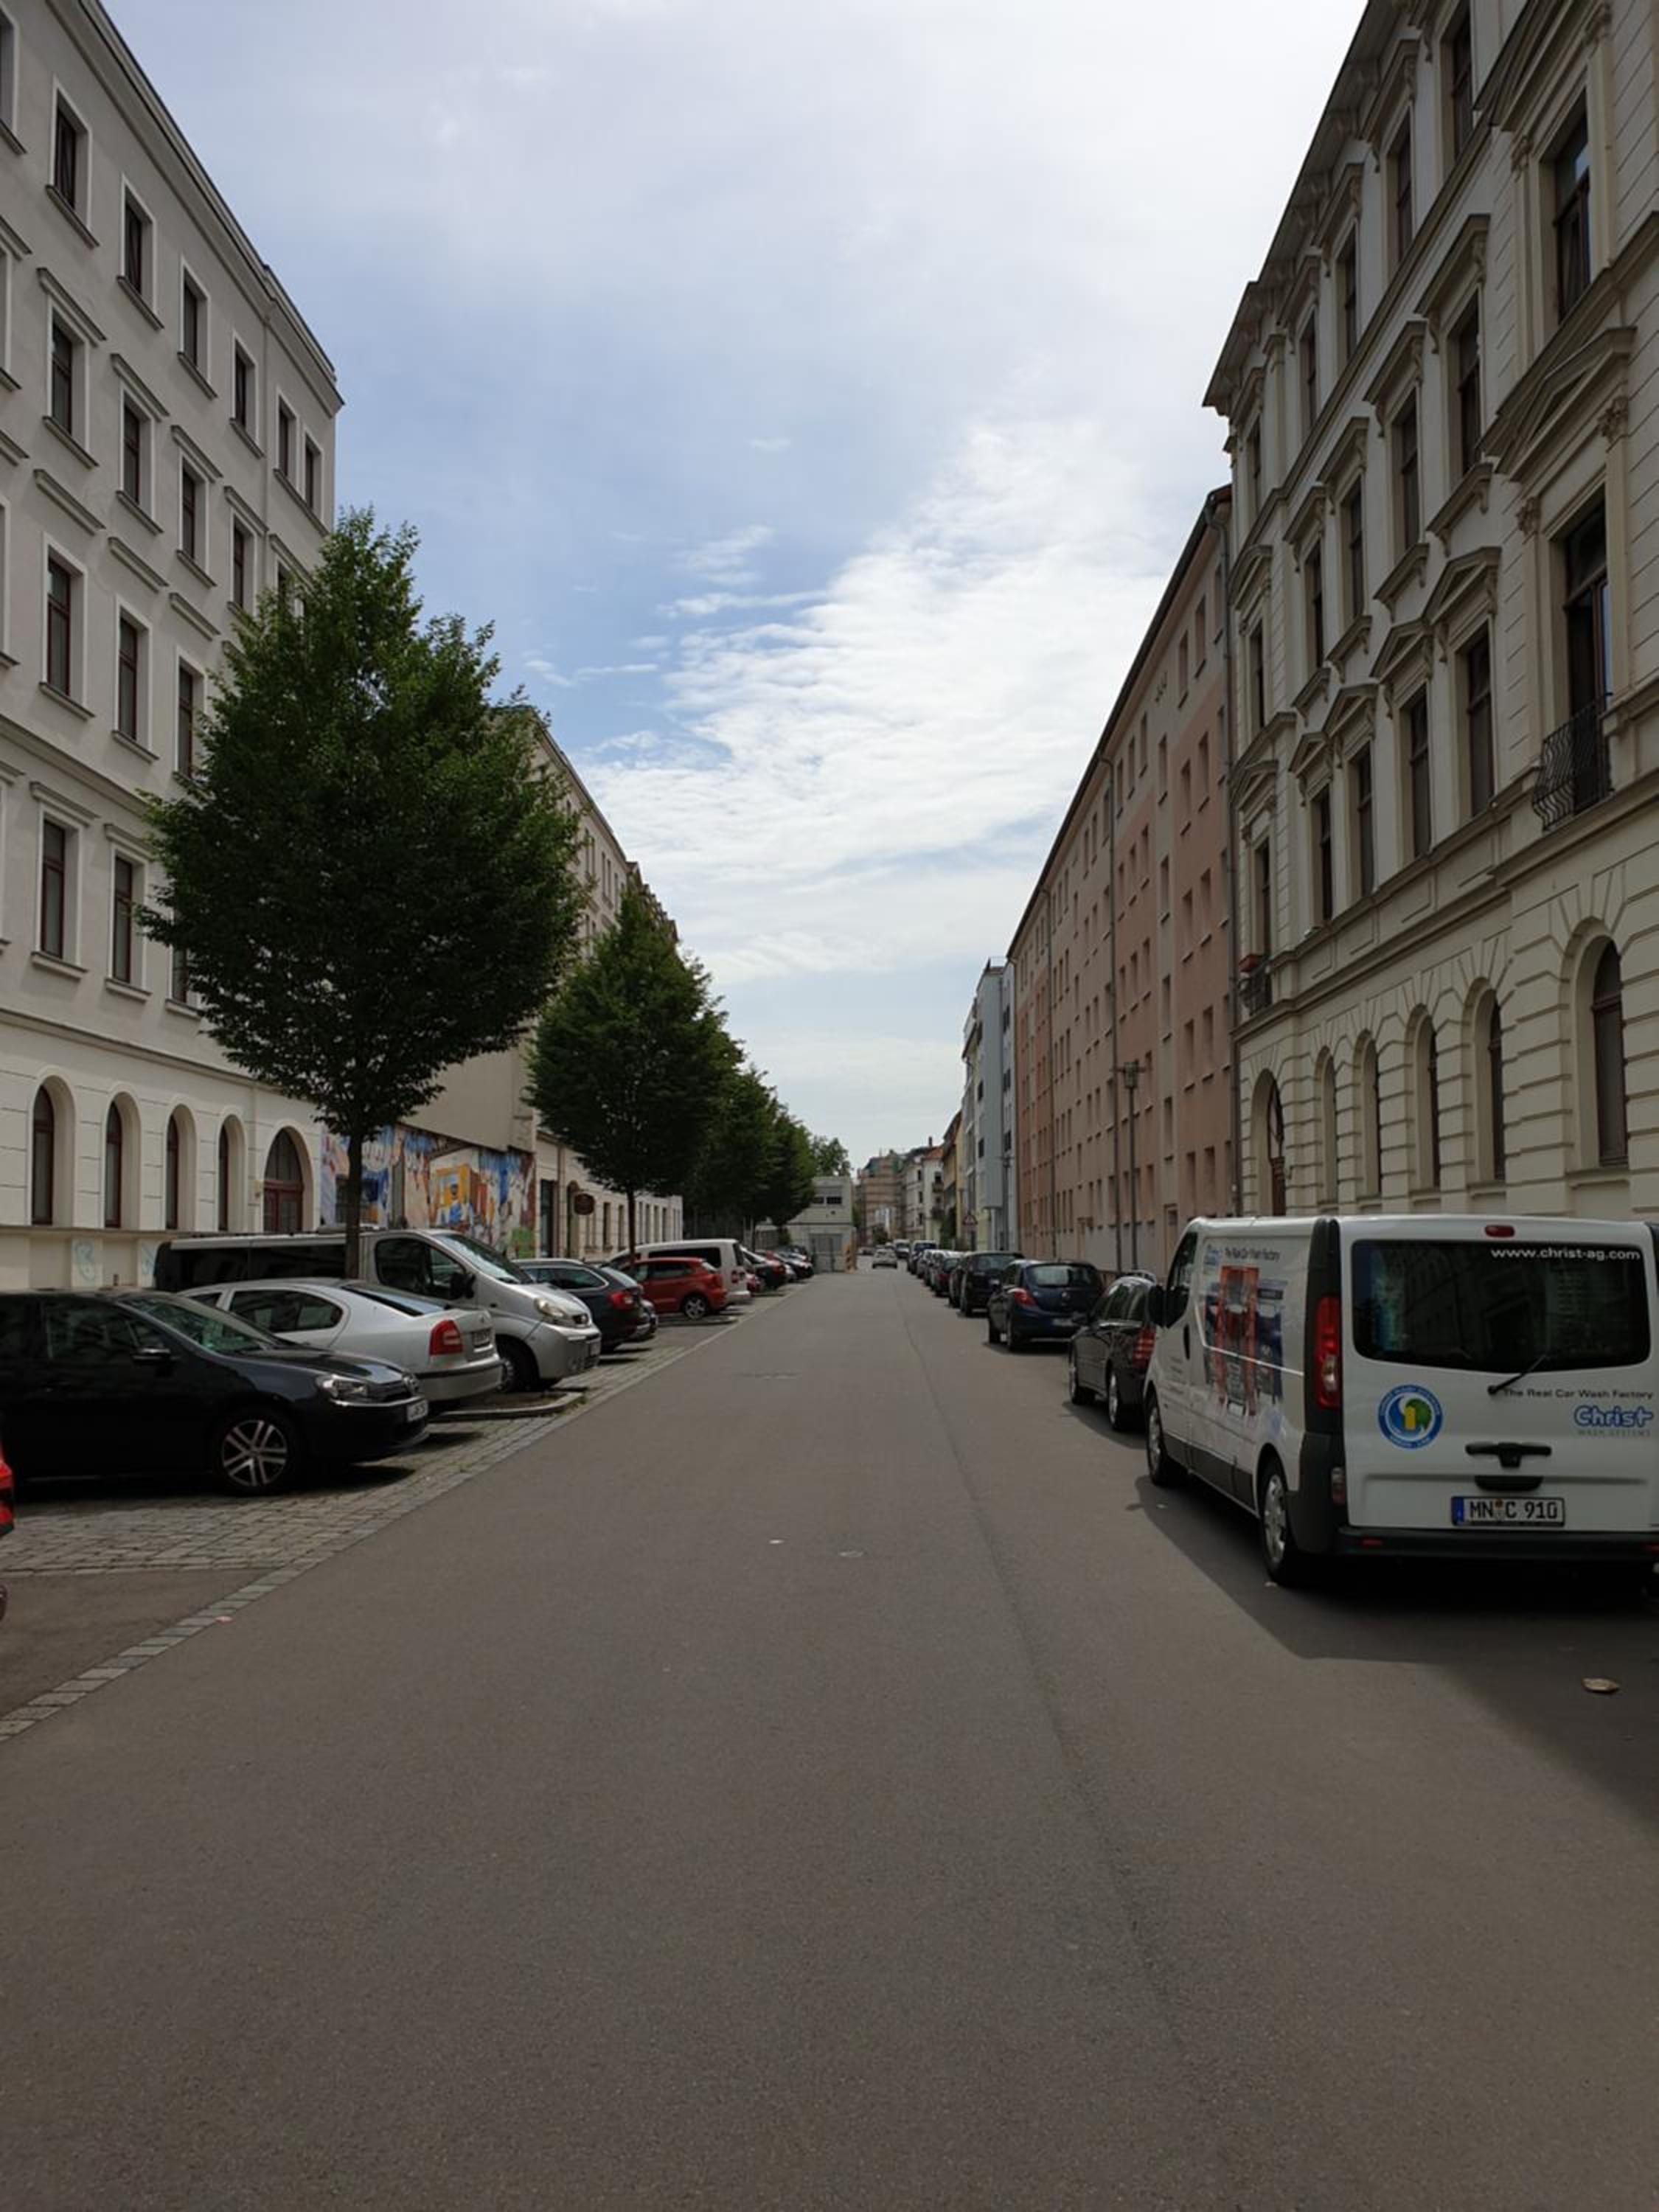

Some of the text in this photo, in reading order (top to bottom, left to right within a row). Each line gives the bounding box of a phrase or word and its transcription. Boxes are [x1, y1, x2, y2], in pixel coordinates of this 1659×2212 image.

[1490, 1248, 1641, 1261] www.christ-ag.com
[1528, 1389, 1552, 1398] Real
[1555, 1389, 1576, 1398] Car
[1579, 1389, 1609, 1398] Wash
[1613, 1389, 1653, 1400] Factory
[1574, 1405, 1655, 1427] Christ
[1469, 1500, 1558, 1519] MN C 910
